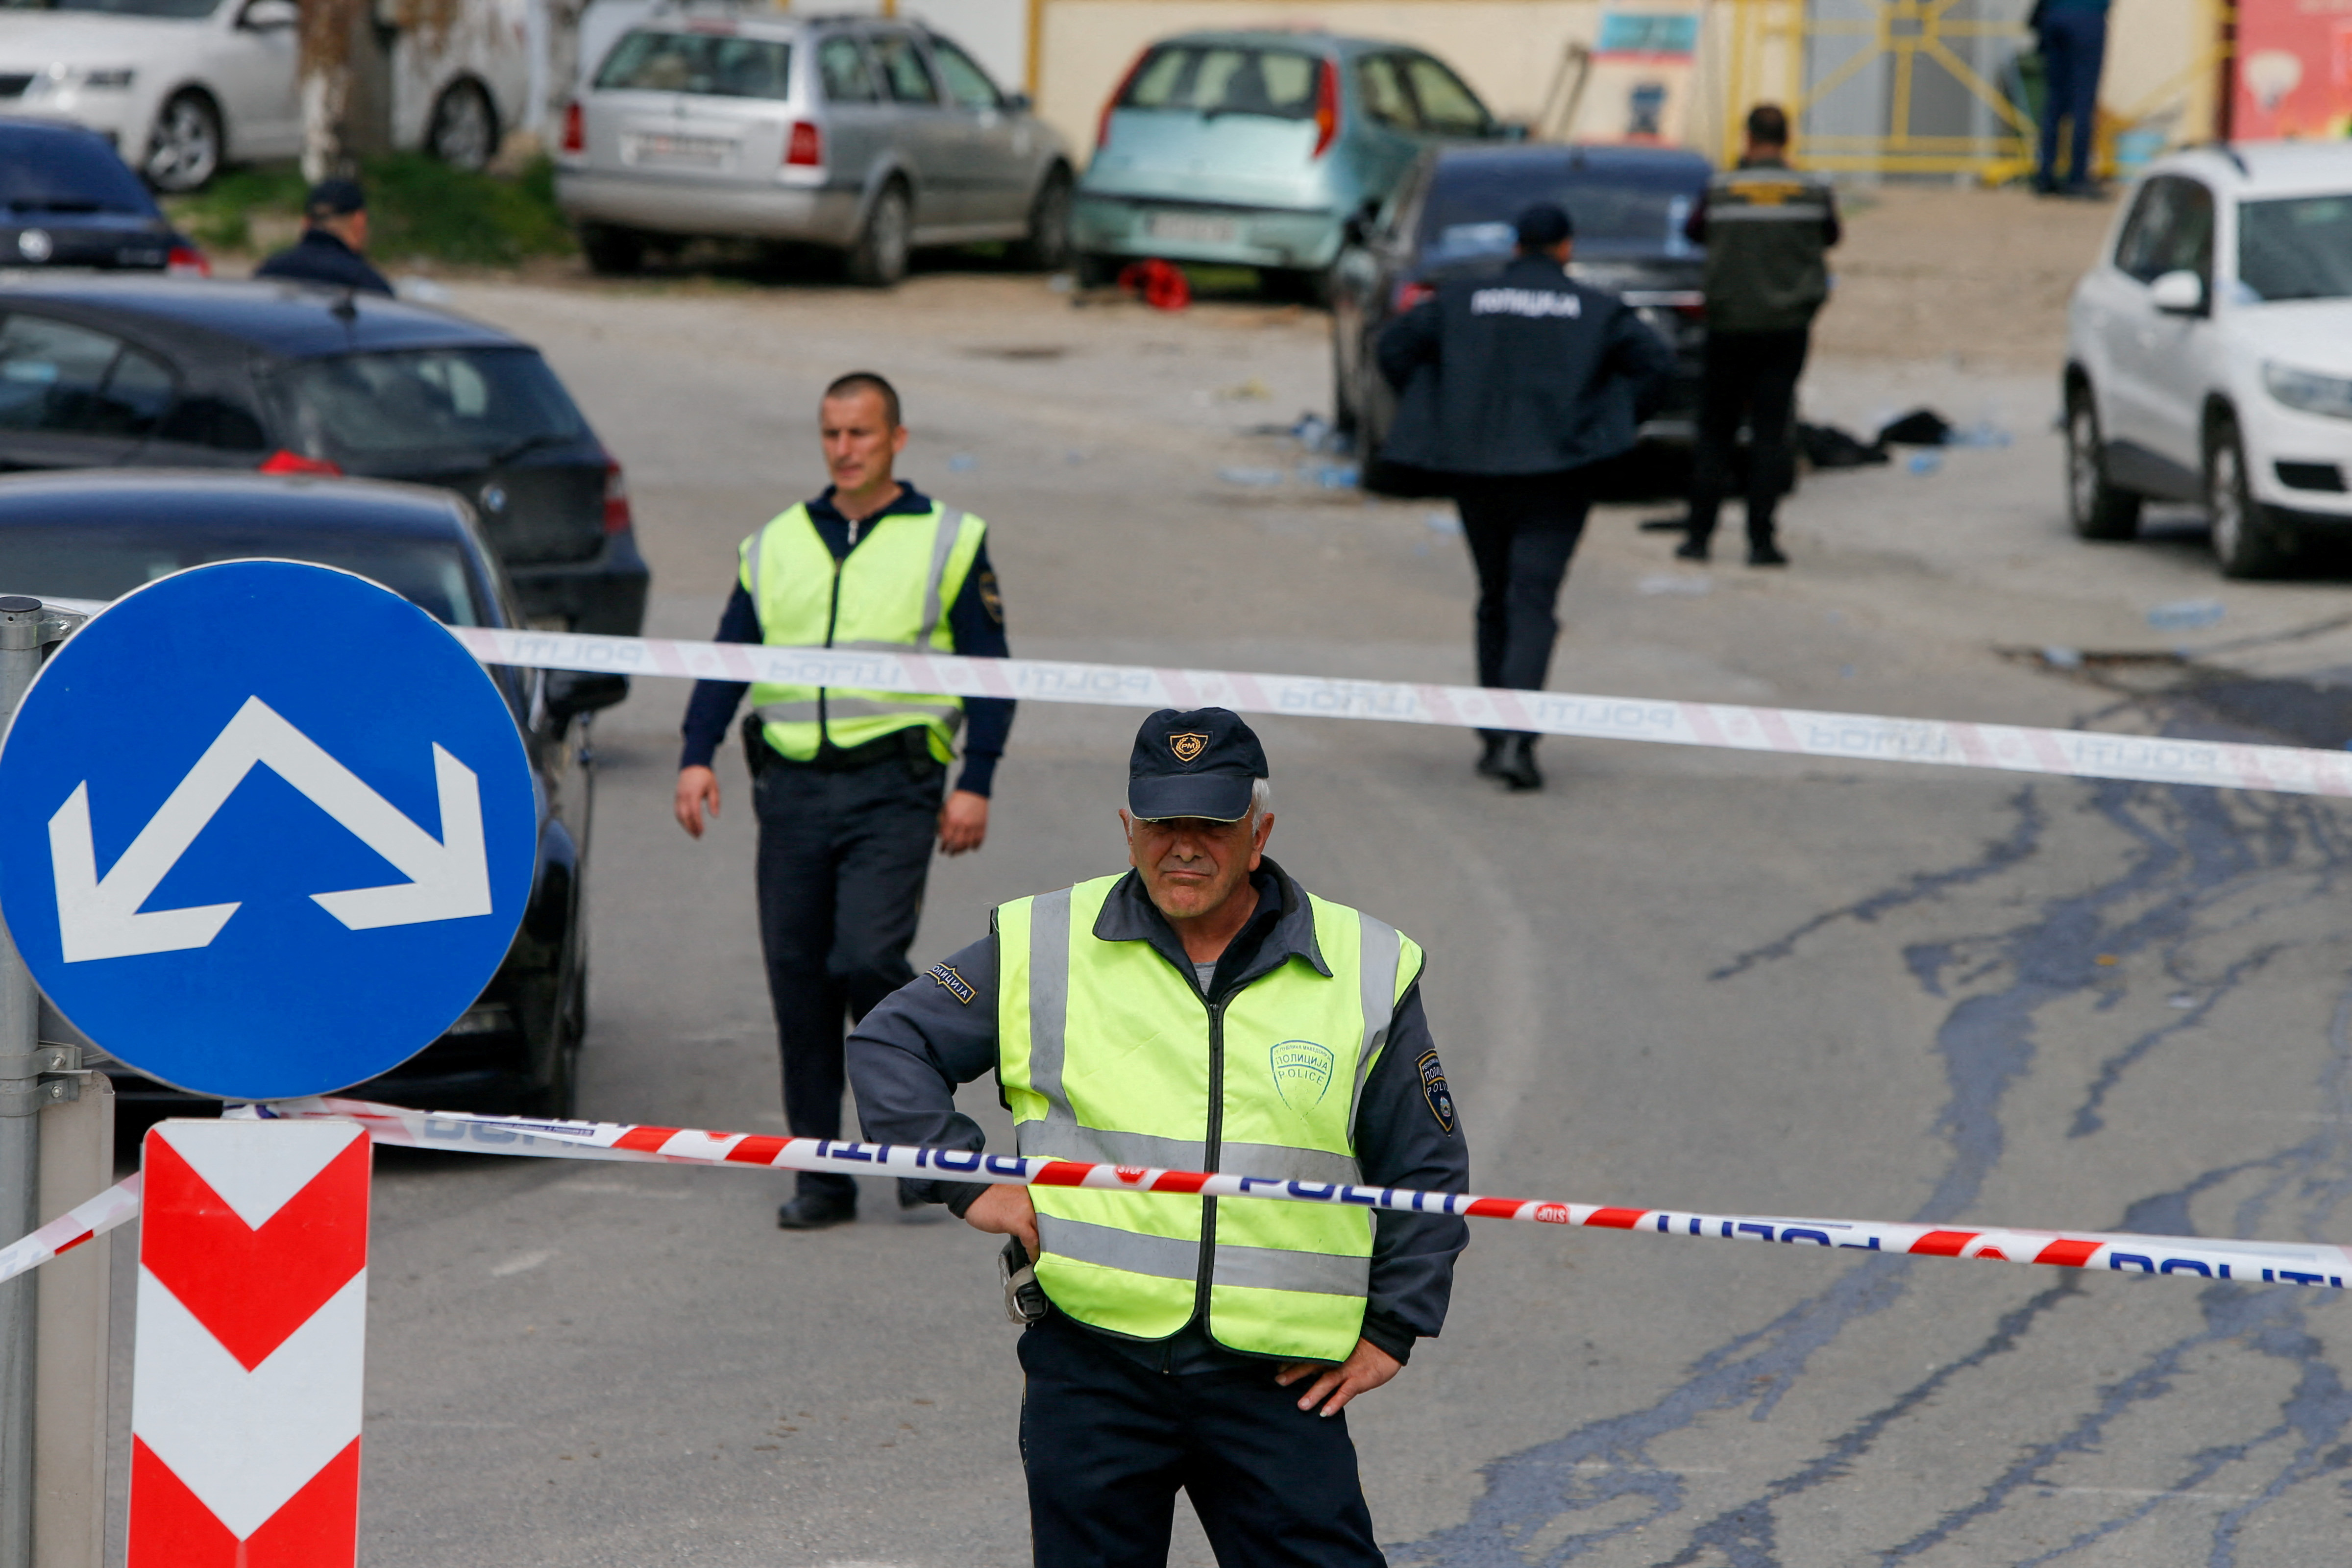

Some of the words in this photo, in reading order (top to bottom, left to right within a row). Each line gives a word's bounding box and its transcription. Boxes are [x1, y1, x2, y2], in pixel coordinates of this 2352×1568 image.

[930, 965, 968, 998] ОЛИЦИЈА
[1275, 1053, 1328, 1071] ПОЛИЦИЈА
[1278, 1069, 1324, 1086] POLICE
[1538, 1208, 1566, 1223] STOP
